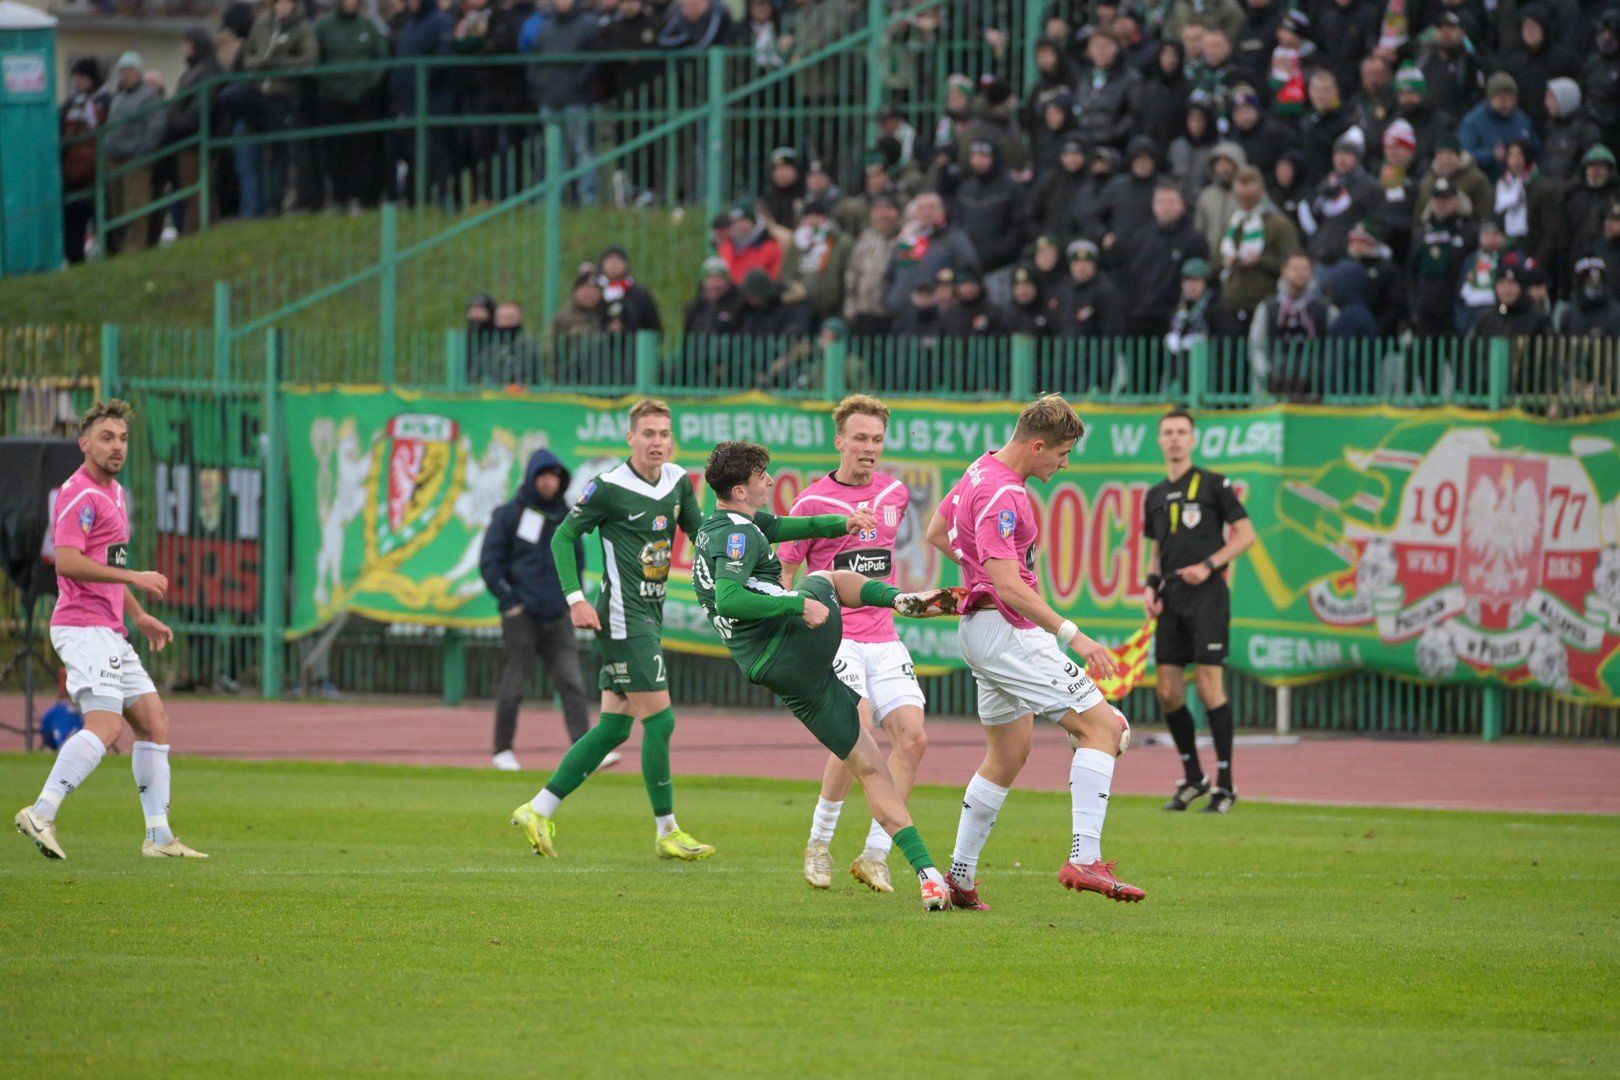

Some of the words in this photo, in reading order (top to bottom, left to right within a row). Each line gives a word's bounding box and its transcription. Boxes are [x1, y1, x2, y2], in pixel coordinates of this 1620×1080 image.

[680, 412, 826, 447] PIERWSI
[1110, 423, 1147, 456] W
[1412, 480, 1459, 536] 19
[1549, 485, 1588, 541] 77
[849, 554, 886, 573] VetPuls
